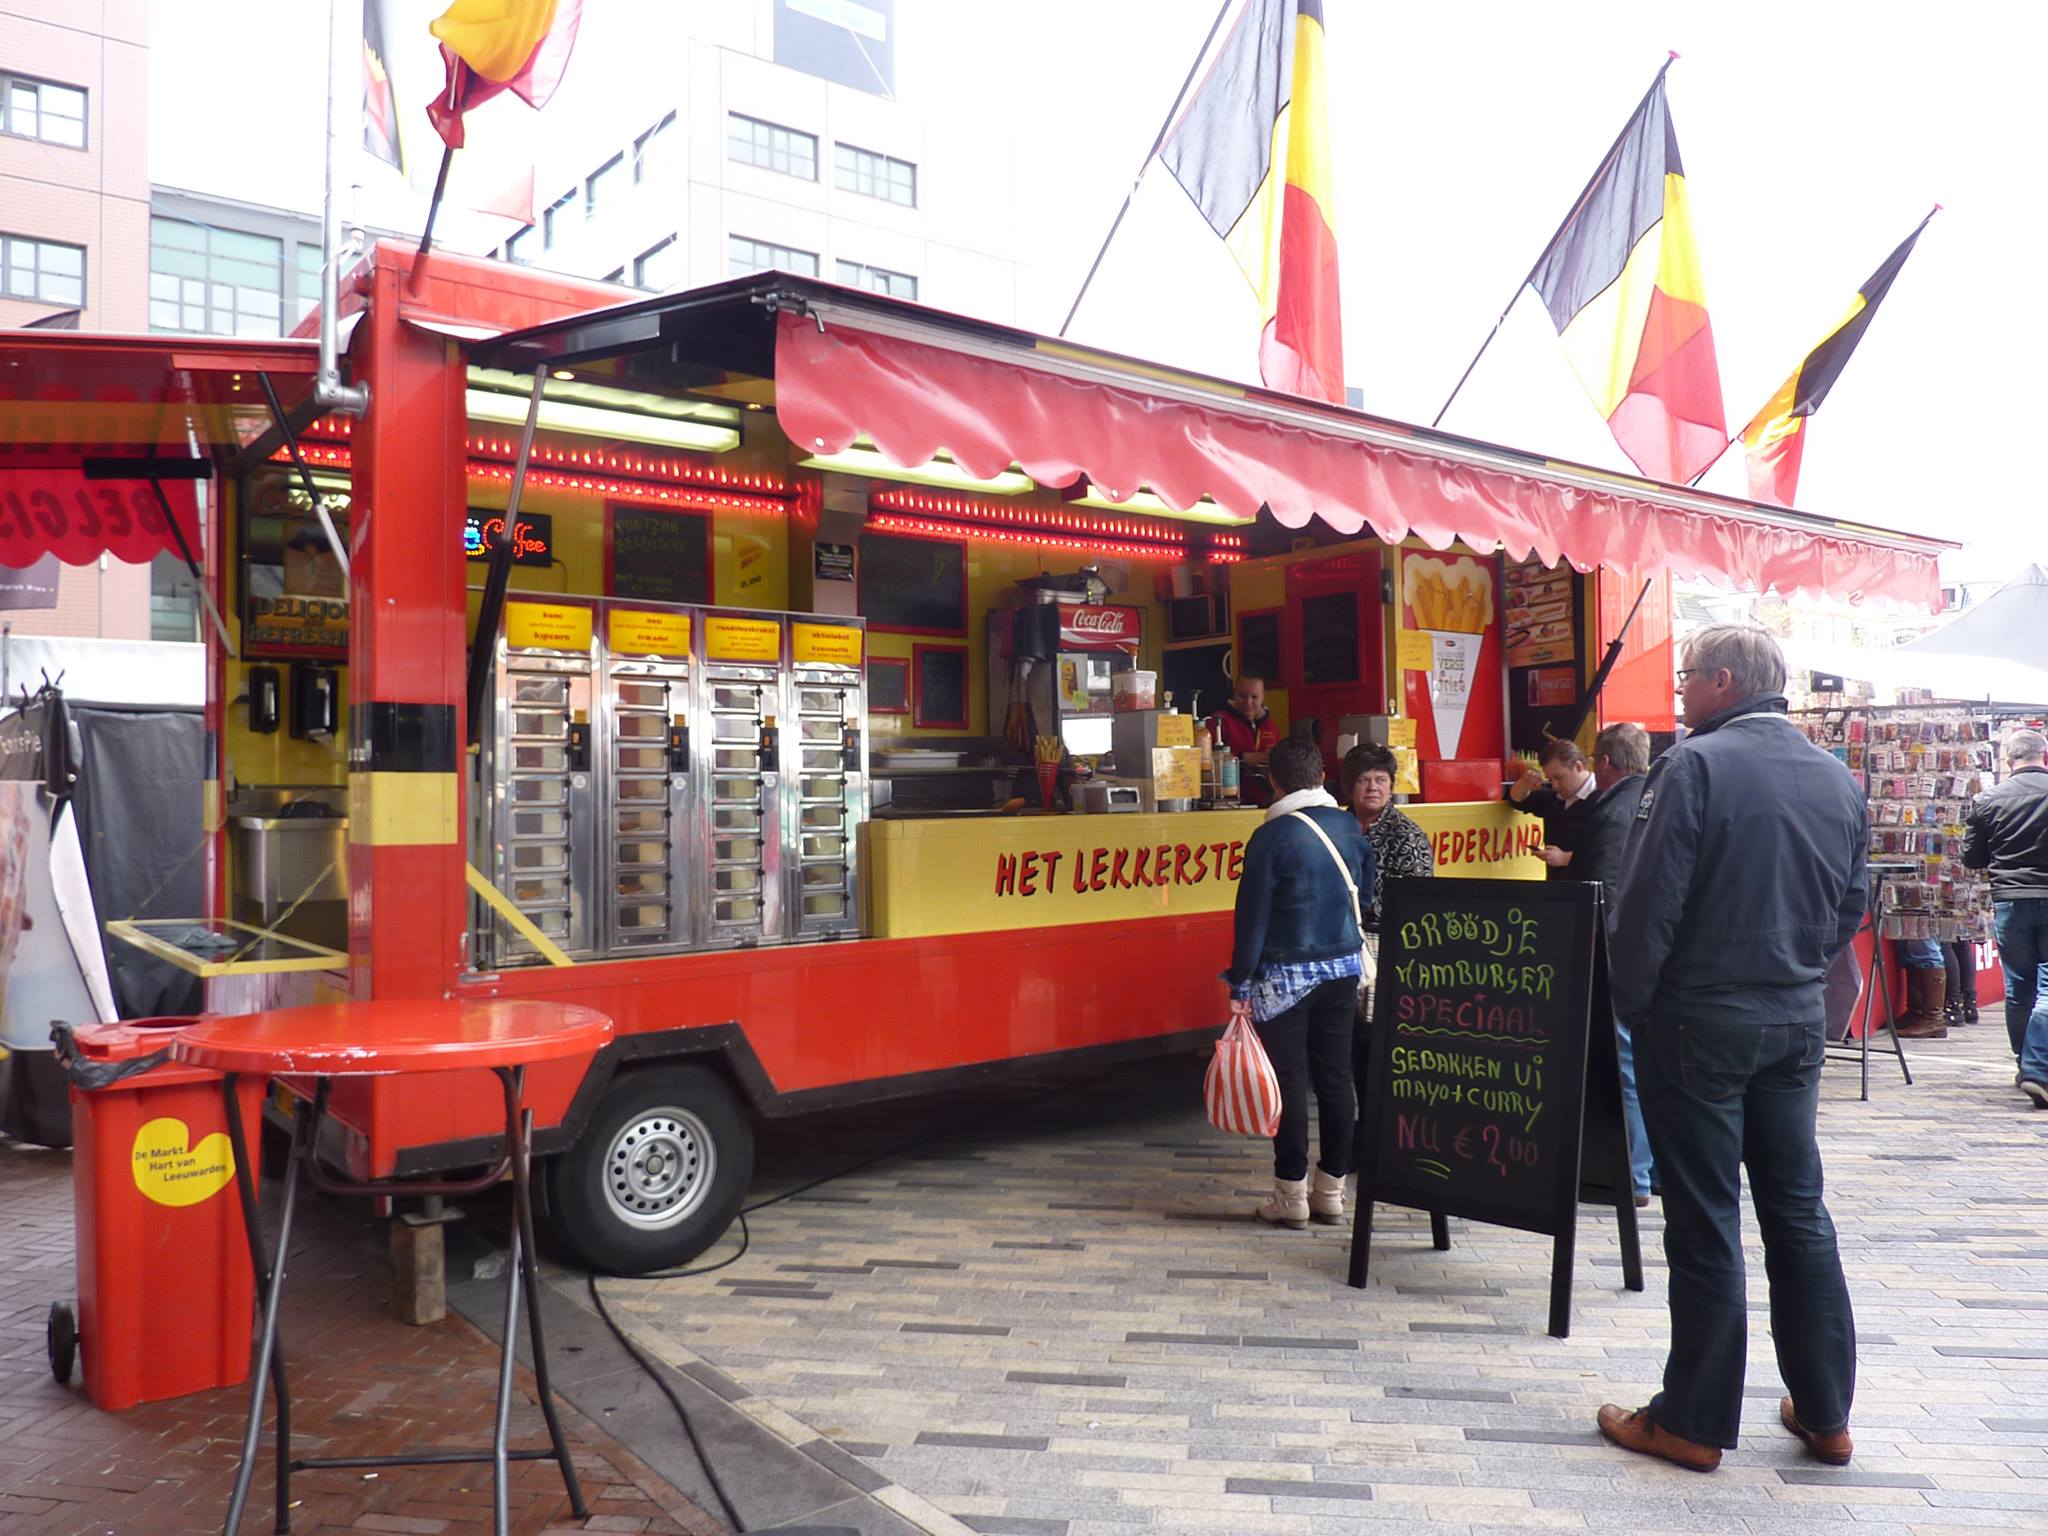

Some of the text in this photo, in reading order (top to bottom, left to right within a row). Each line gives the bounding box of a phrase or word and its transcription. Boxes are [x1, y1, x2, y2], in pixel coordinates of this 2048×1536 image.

[483, 517, 547, 558] Cffee
[1073, 608, 1125, 633] Coca-Cola
[533, 631, 571, 641] kipcorn
[995, 851, 1064, 897] HET
[1073, 840, 1245, 894] LEKKERSTE
[1395, 958, 1554, 1000] HAMBURGER
[1391, 1046, 1501, 1080] GEBAKKEN
[1398, 1113, 1441, 1152] NU
[135, 1151, 147, 1160] De
[149, 1158, 196, 1171] Hart van
[163, 1164, 227, 1182] Leeuwarden
